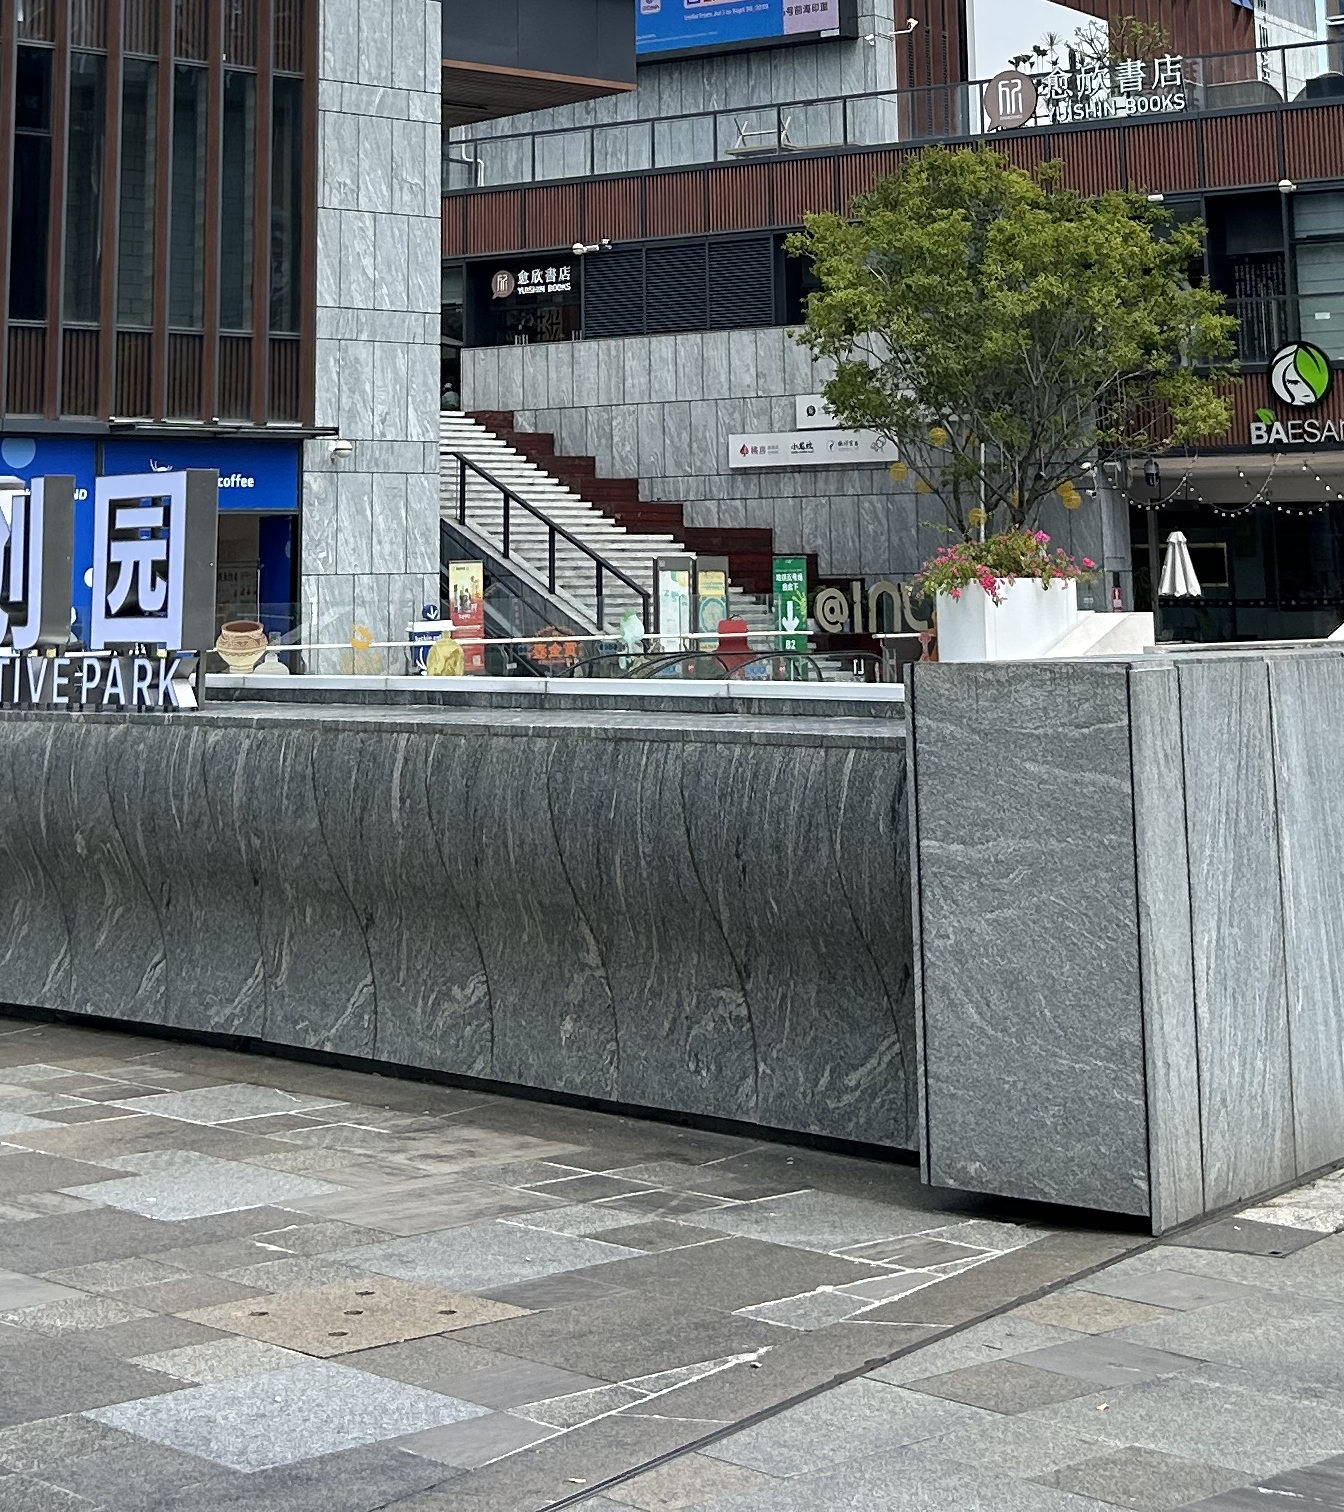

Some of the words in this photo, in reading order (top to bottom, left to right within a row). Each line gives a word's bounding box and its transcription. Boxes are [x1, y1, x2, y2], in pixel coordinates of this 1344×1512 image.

[1042, 54, 1183, 100] 愈欣書店
[1047, 99, 1117, 123] YUISHIN
[1126, 92, 1186, 115] BOOKS
[217, 473, 255, 488] coffee
[81, 657, 182, 707] PARK
